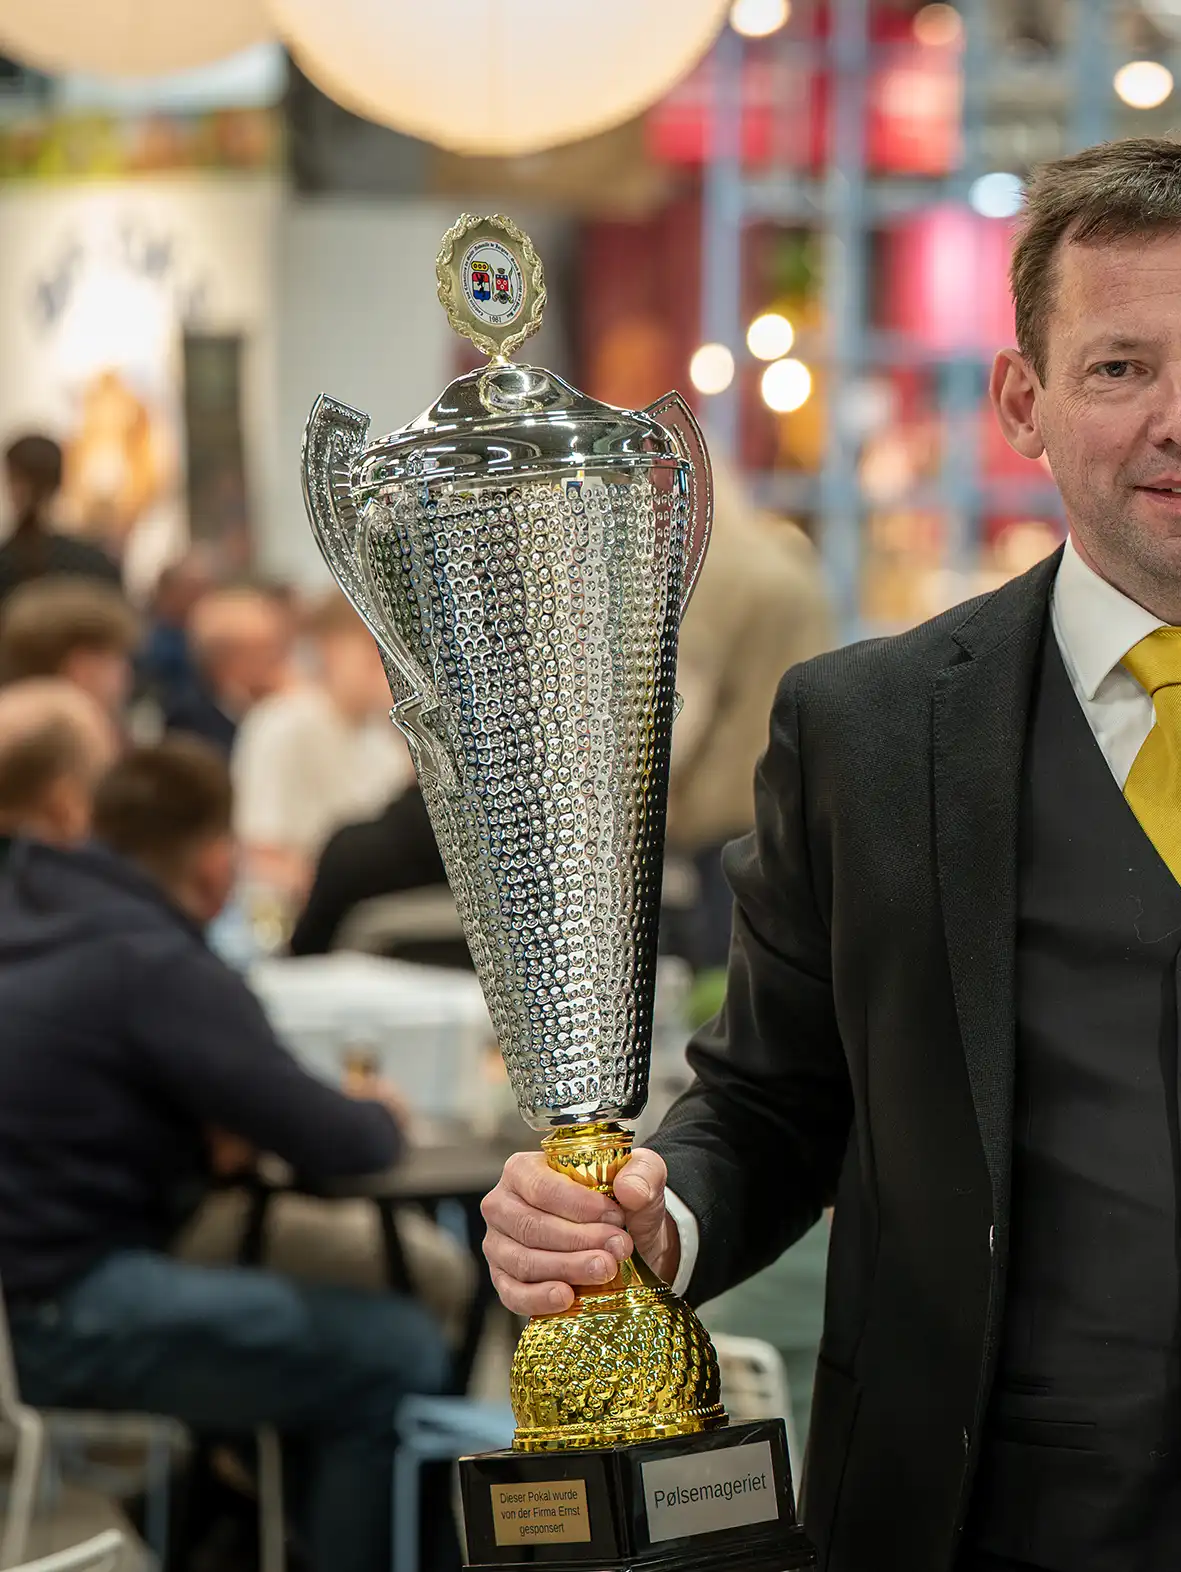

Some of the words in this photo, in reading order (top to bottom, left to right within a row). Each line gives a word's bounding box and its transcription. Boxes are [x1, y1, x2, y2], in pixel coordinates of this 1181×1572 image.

[500, 1492, 526, 1504] Dieser
[528, 1490, 551, 1502] Pokal
[552, 1488, 578, 1501] wurde
[654, 1473, 767, 1509] Pølsemageriet
[501, 1510, 516, 1520] von
[517, 1507, 531, 1519] der
[533, 1506, 557, 1518] Firma
[558, 1505, 580, 1517] Ernst
[519, 1522, 565, 1538] gesponsert
